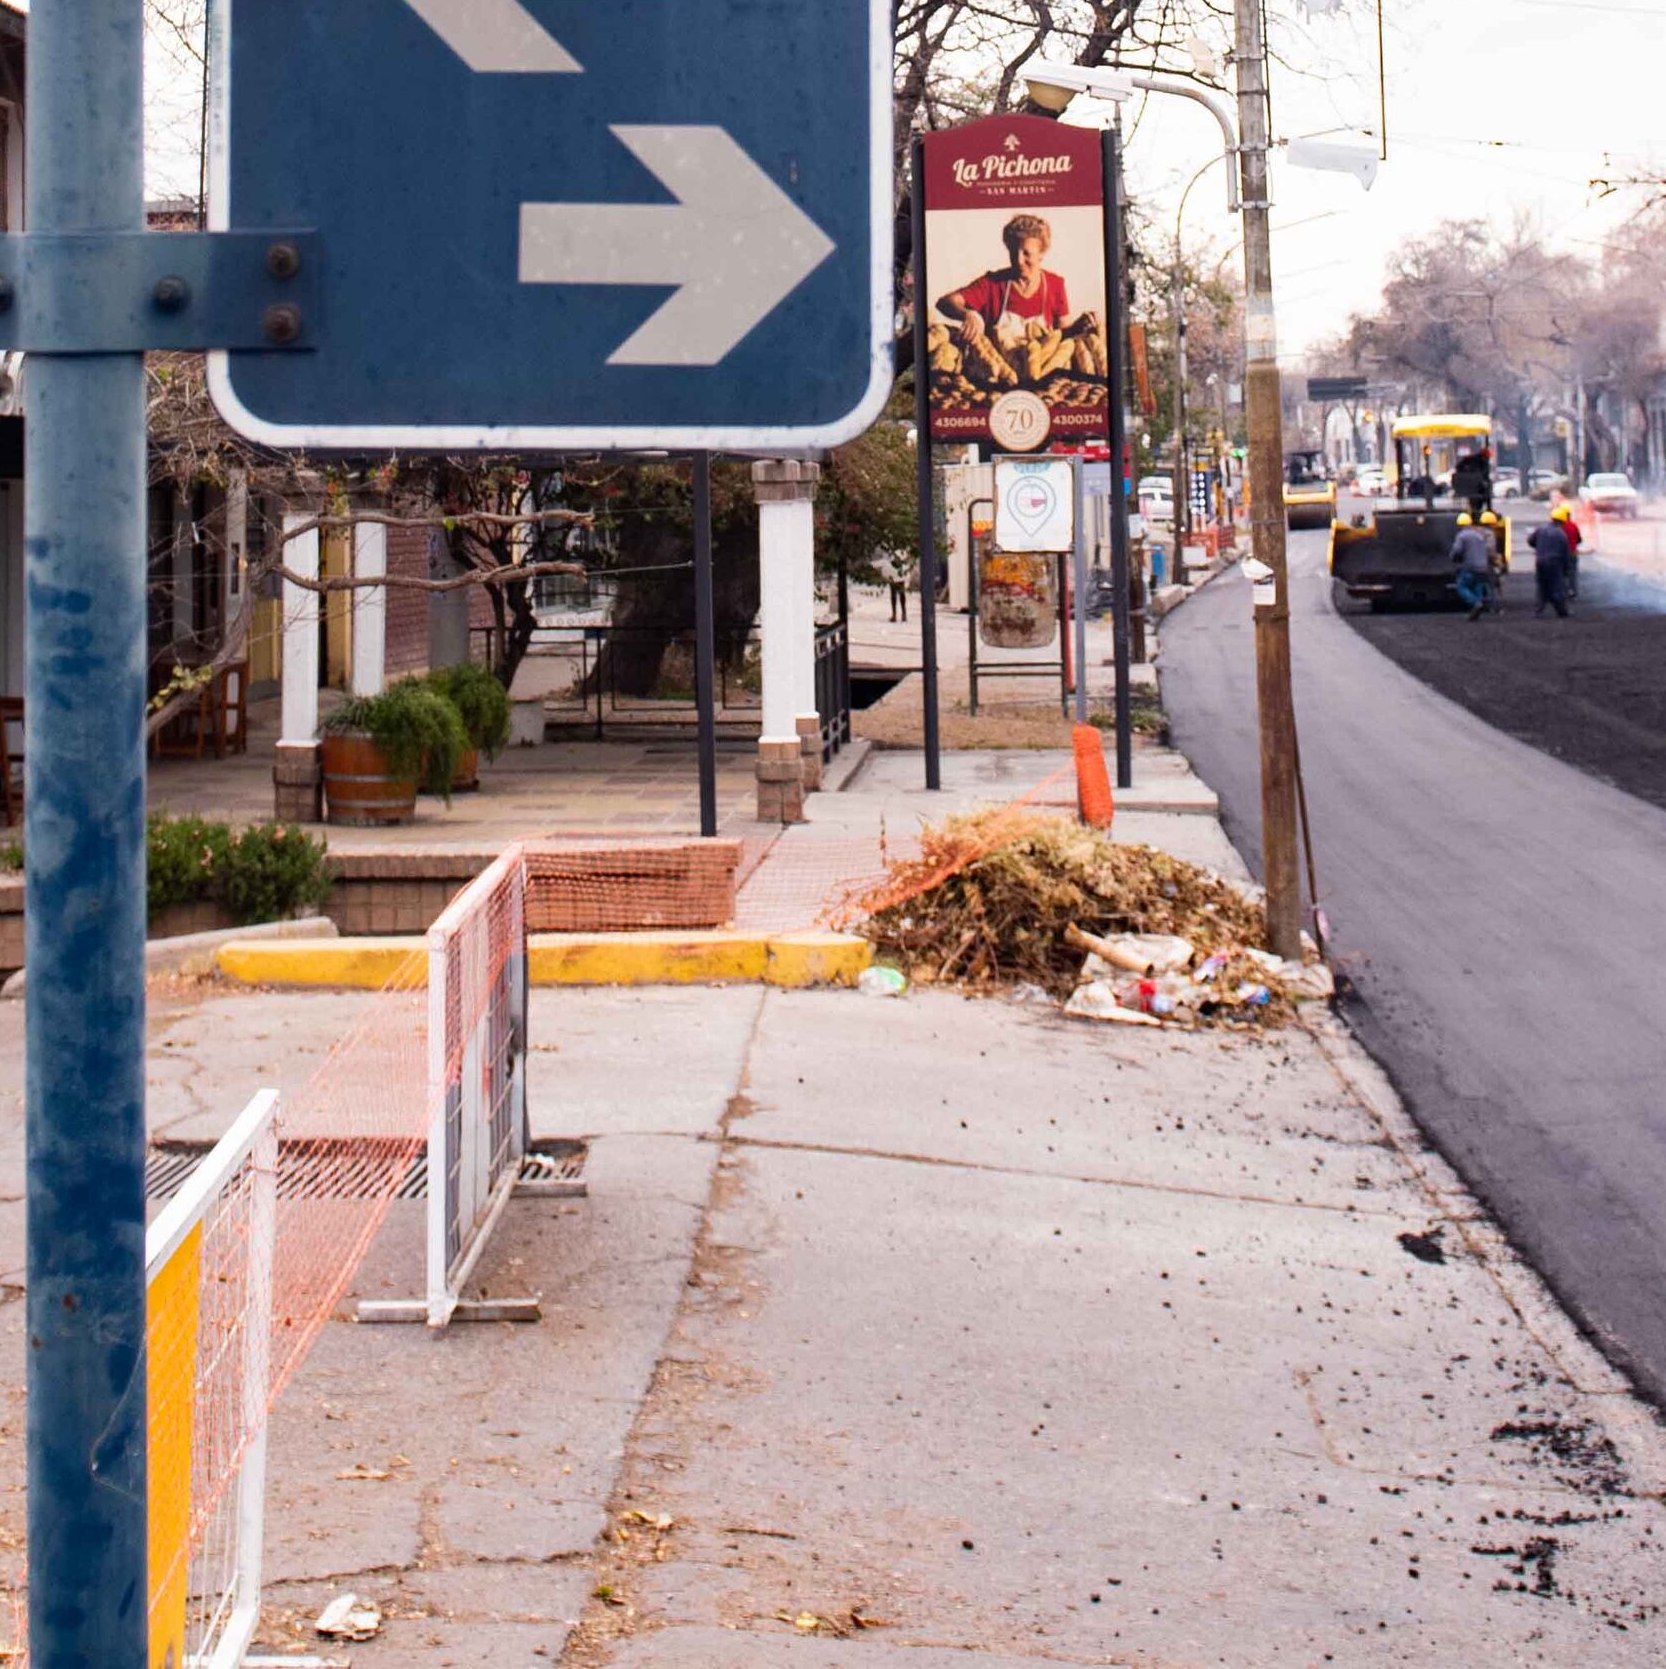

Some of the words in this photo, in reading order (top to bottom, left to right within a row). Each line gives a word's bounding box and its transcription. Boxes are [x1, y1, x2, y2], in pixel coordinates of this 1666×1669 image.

[952, 157, 981, 188] La
[982, 153, 1073, 180] Pichona
[1005, 408, 1034, 431] 70
